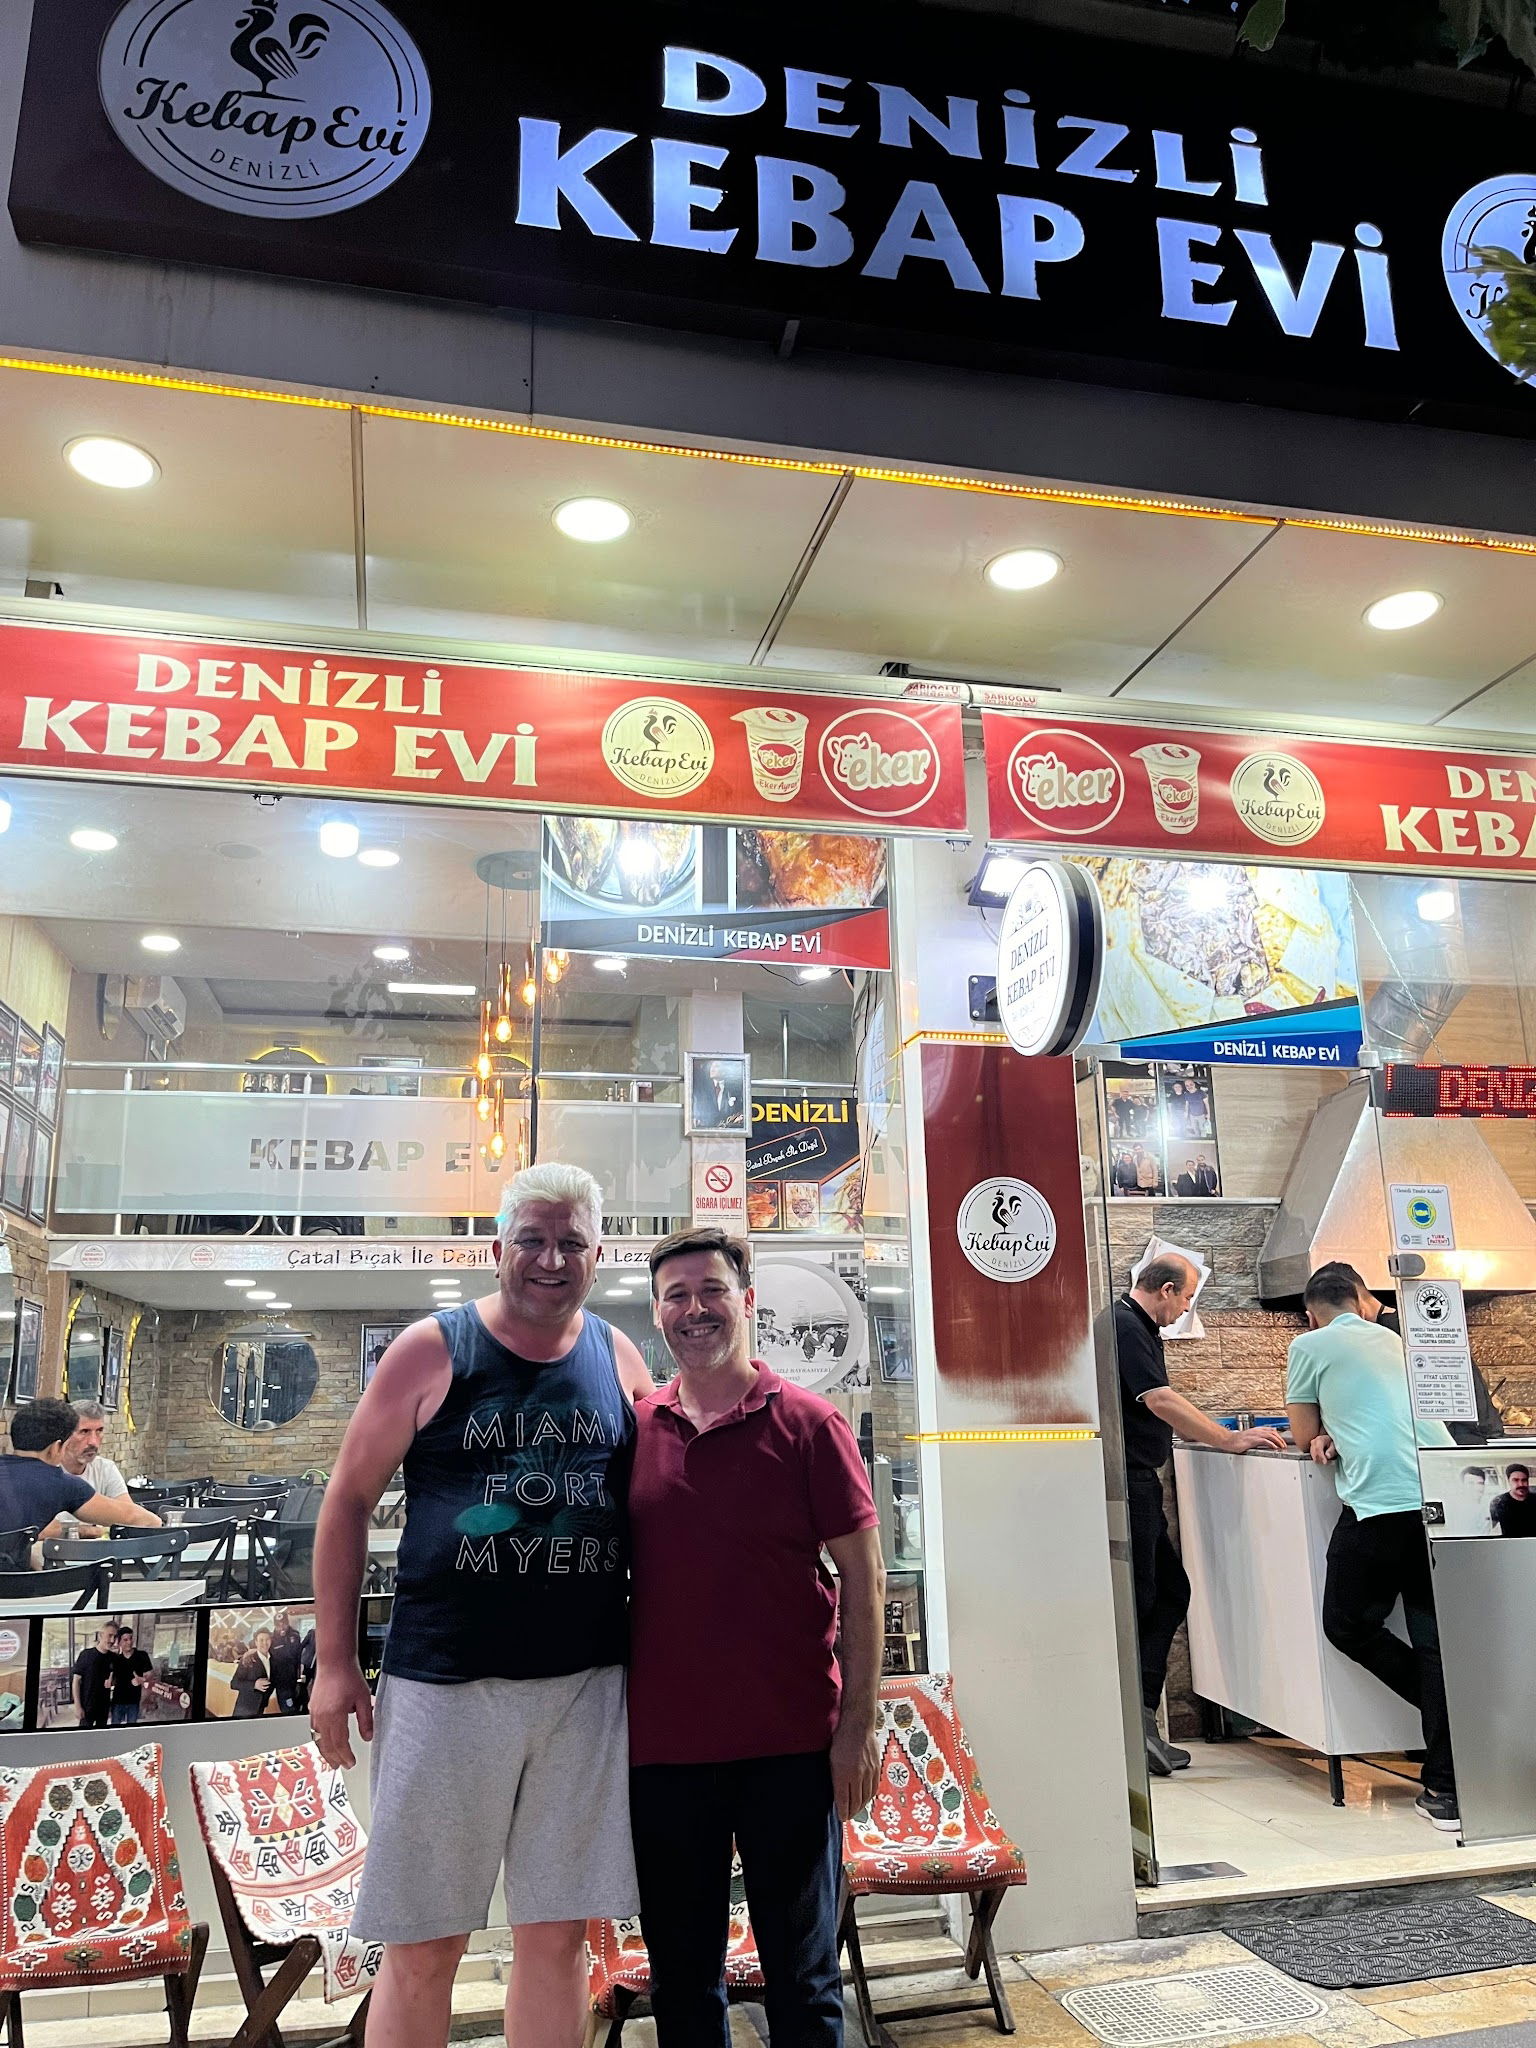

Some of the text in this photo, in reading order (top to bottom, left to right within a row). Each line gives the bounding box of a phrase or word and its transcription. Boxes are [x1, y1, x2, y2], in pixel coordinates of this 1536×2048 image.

[123, 77, 408, 158] Kebap Evi
[662, 45, 1268, 206] DENİZLİ
[209, 148, 320, 180] DENİZLİ
[515, 116, 1400, 351] KEBAP EVİ
[134, 653, 443, 717] DENİZLİ
[18, 695, 539, 787] KEBAP EVİ
[610, 746, 709, 774] Kebap Evi
[766, 752, 796, 768] eker
[848, 742, 929, 788] eker
[1037, 765, 1114, 805] eker
[1240, 799, 1322, 823] Kebap Evi
[1379, 803, 1536, 858] KEB
[637, 922, 822, 954] DENİZLİ KEBAP EVİ
[1010, 919, 1049, 970] DENİZLİ
[1006, 968, 1037, 1007] KEBAP
[1213, 1039, 1341, 1062] DENİZLİ KEBAP EVİ
[249, 1138, 425, 1172] KEBAP
[287, 1249, 341, 1269] Çatal
[412, 1246, 434, 1264] İle
[442, 1249, 489, 1267] Değil
[965, 1231, 1051, 1257] Kebap Evi
[483, 1472, 608, 1507] FORT
[456, 1535, 622, 1575] MYERS
[1327, 1926, 1473, 1955] WELCOME
